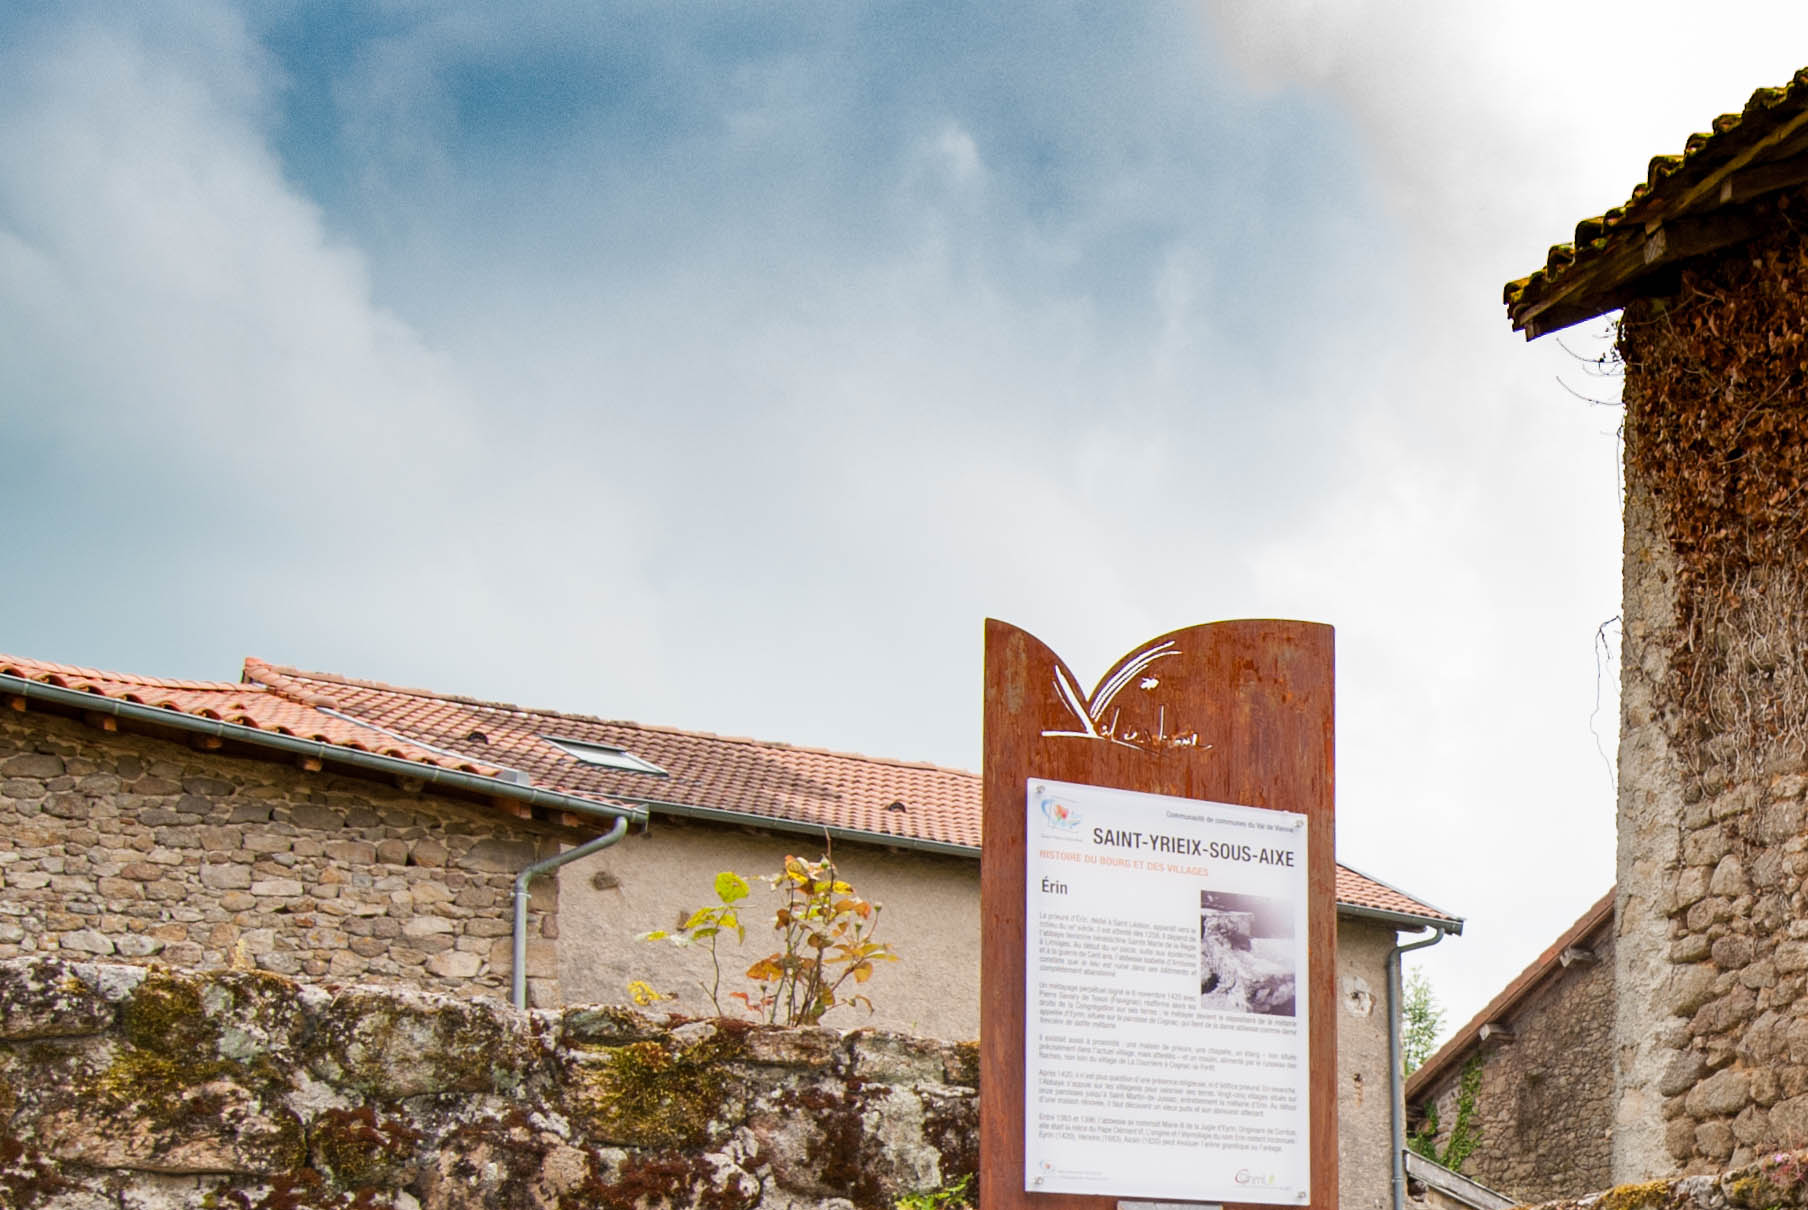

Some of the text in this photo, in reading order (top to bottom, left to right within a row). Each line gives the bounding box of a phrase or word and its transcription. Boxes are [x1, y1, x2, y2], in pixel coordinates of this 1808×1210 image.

[1093, 827, 1294, 867] SAINT-YRIEIX-SOUS-AIXE
[1040, 850, 1209, 877] HISTOIRE DU BOURG ET DES VILLAGES
[1041, 876, 1068, 896] Érin
